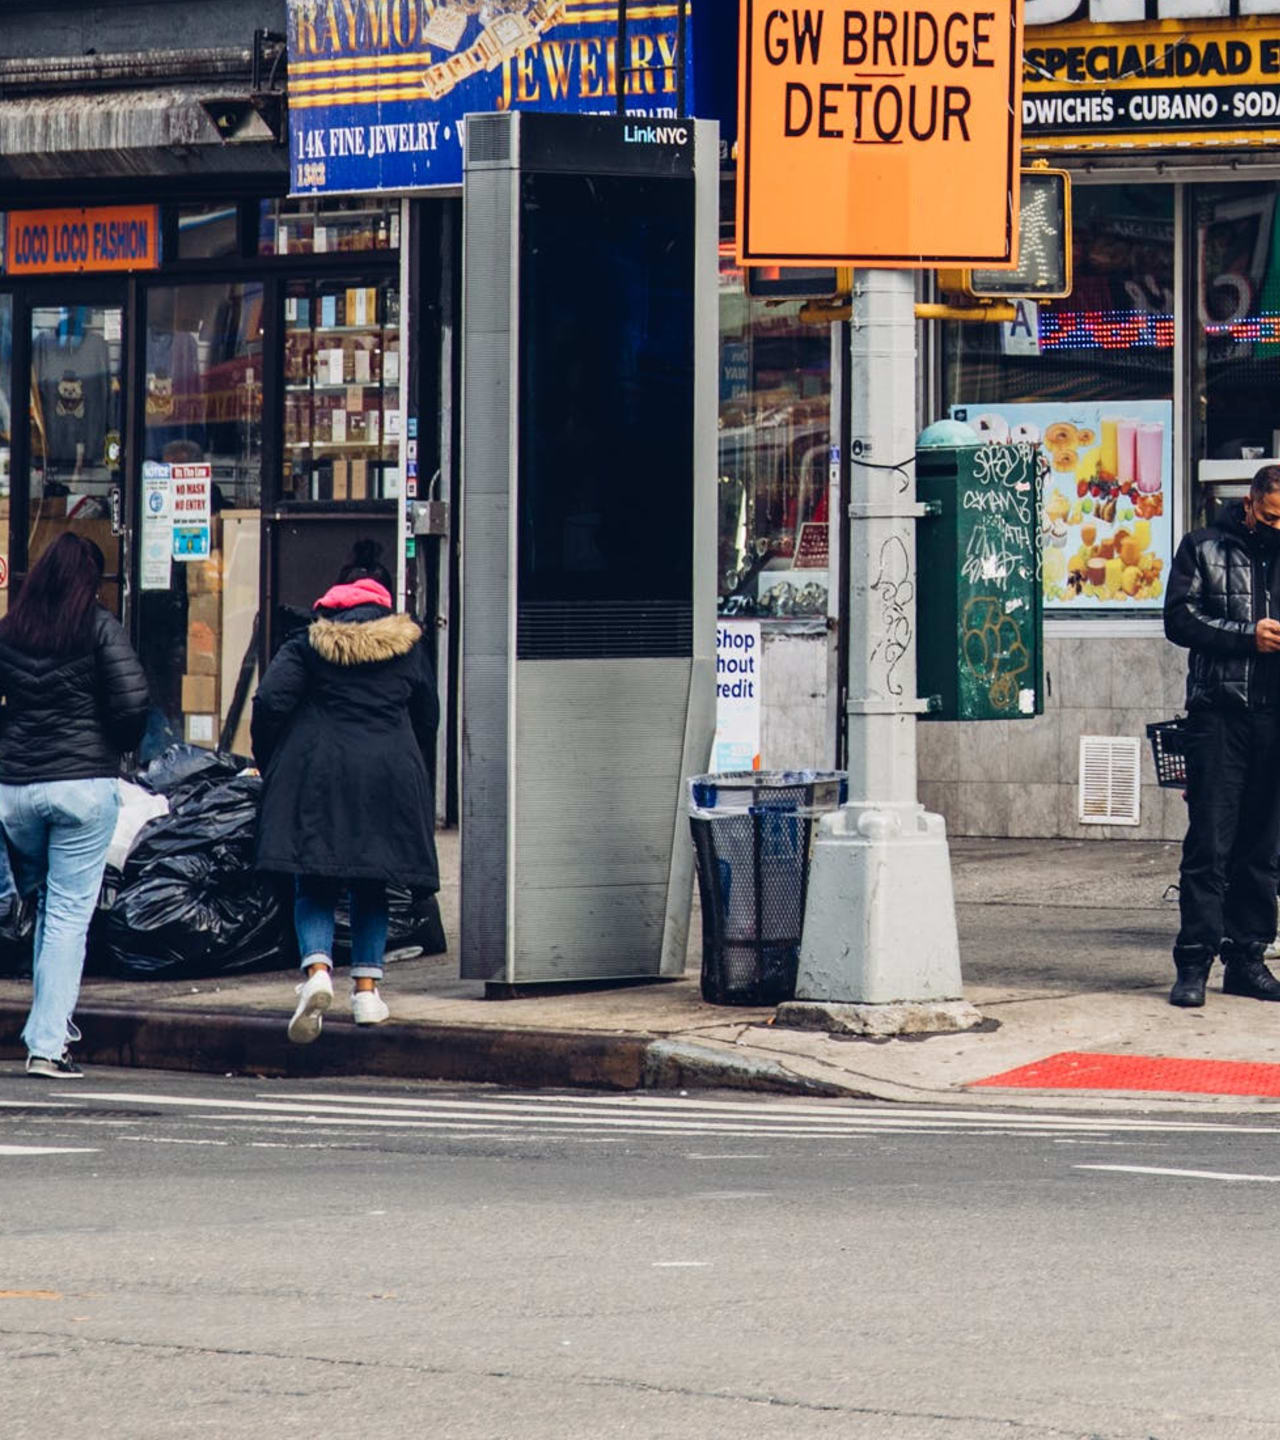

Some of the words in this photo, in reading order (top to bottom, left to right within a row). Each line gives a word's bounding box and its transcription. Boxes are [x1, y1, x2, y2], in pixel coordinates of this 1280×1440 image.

[764, 9, 824, 66] GW
[843, 9, 995, 68] BRIDGE
[496, 34, 677, 111] JEWELRY
[784, 81, 972, 143] DETOUR
[1129, 93, 1219, 121] CUBANO
[298, 129, 326, 159] 14K
[330, 126, 365, 157] FINE
[368, 120, 440, 158] JEWELRY
[624, 125, 687, 145] LinkNYC
[15, 223, 48, 265] LOCO
[54, 222, 88, 263] LOCO
[93, 219, 148, 262] FASHION
[1010, 300, 1032, 337] A
